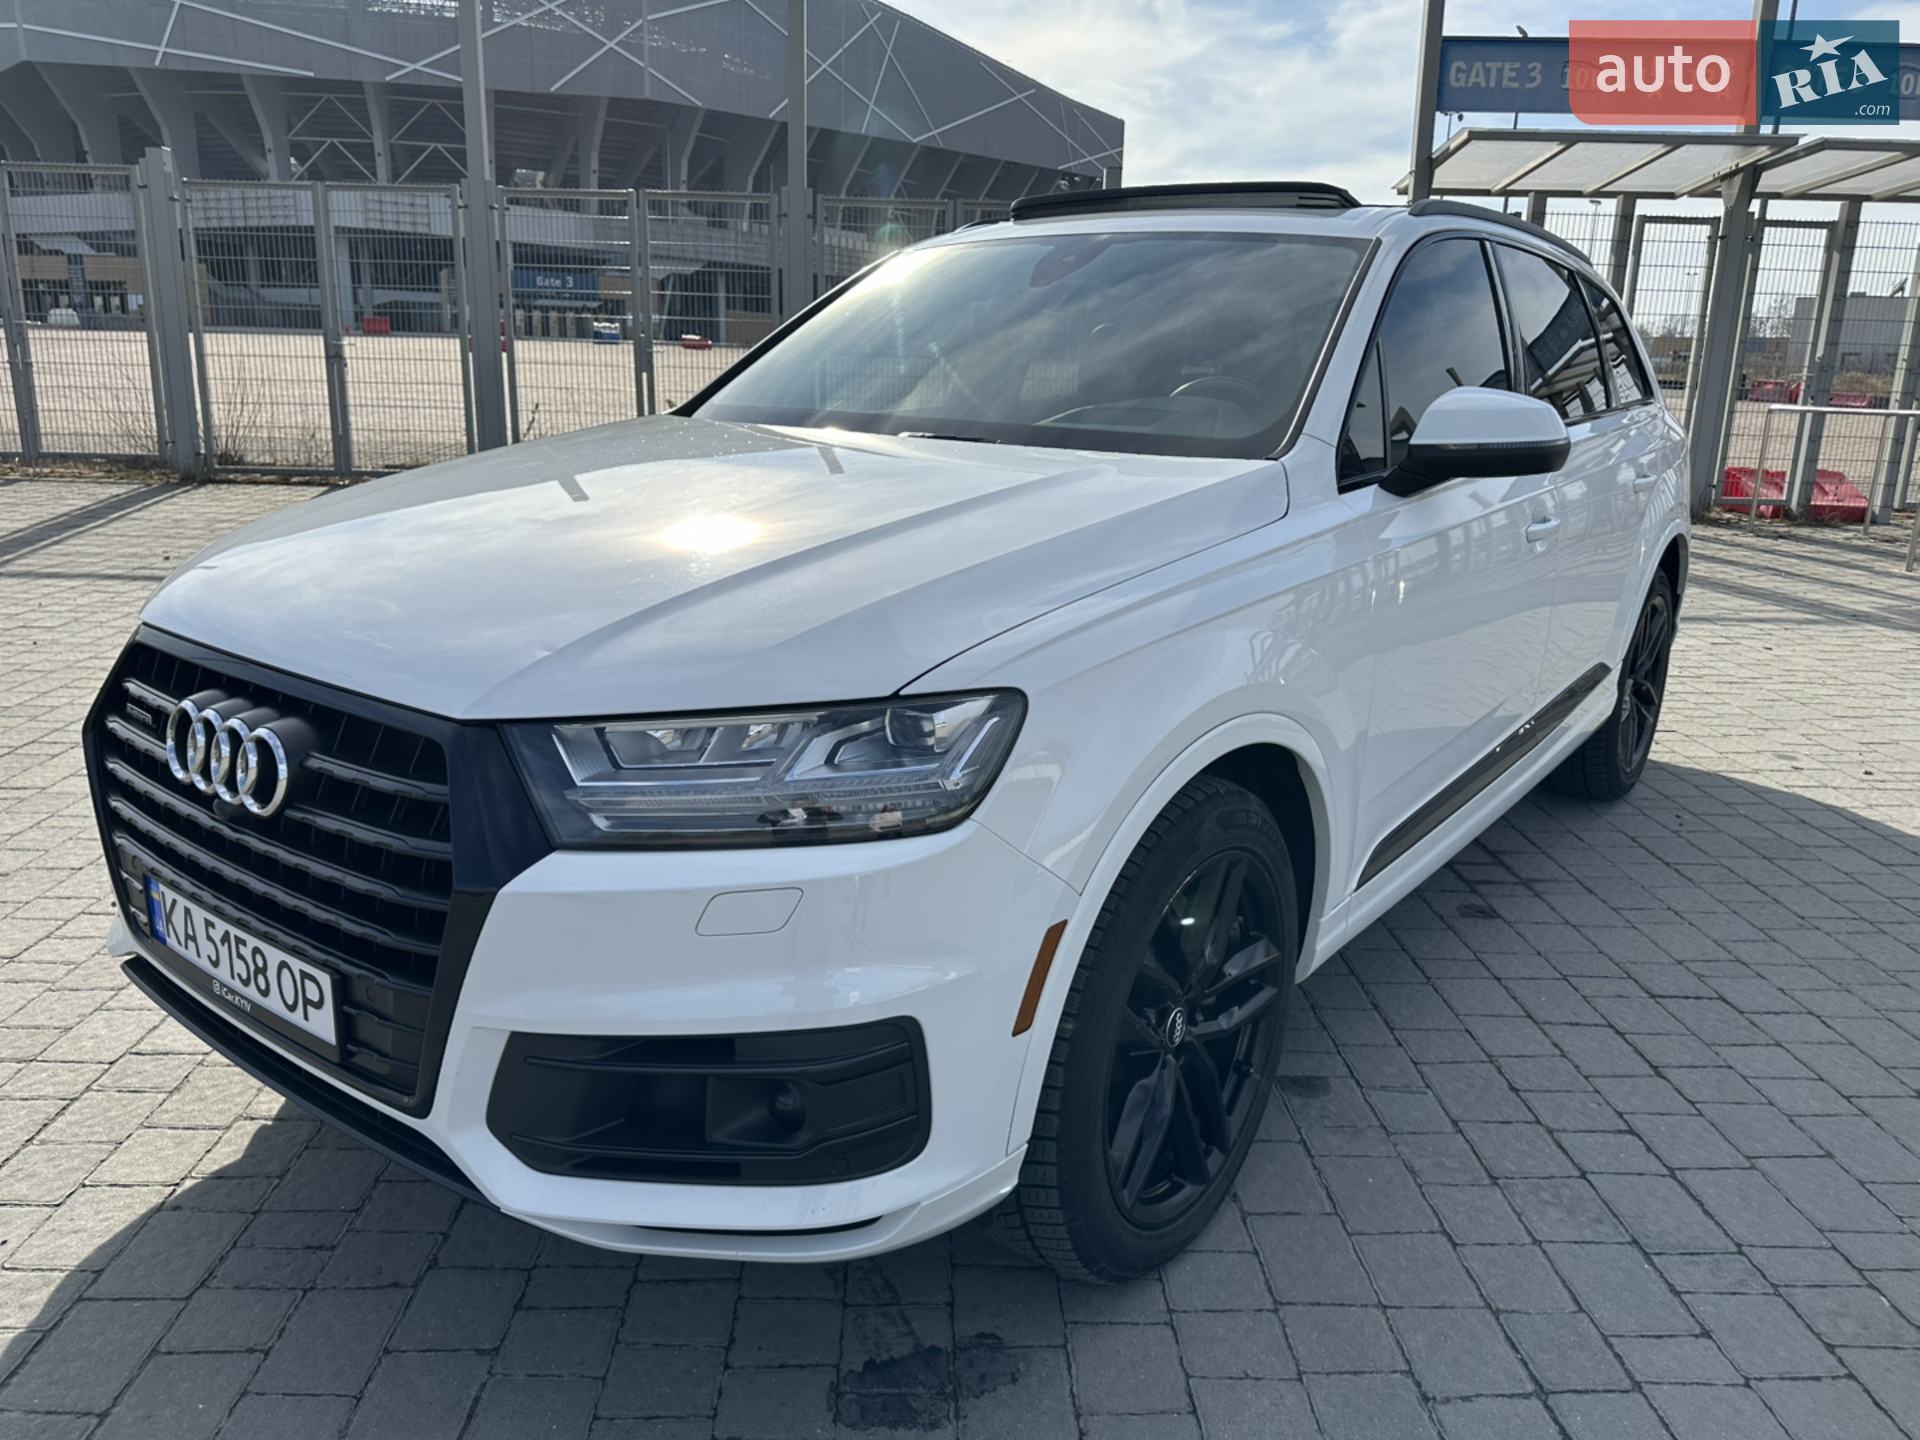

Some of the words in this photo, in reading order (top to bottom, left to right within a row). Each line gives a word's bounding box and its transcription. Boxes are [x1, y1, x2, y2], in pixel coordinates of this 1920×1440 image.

[1448, 60, 1521, 89] GATE
[1524, 61, 1543, 89] 3
[535, 275, 562, 288] Gate
[565, 276, 574, 288] 3
[161, 890, 201, 959] KA
[203, 916, 271, 998] 5158
[276, 959, 325, 1023] OP
